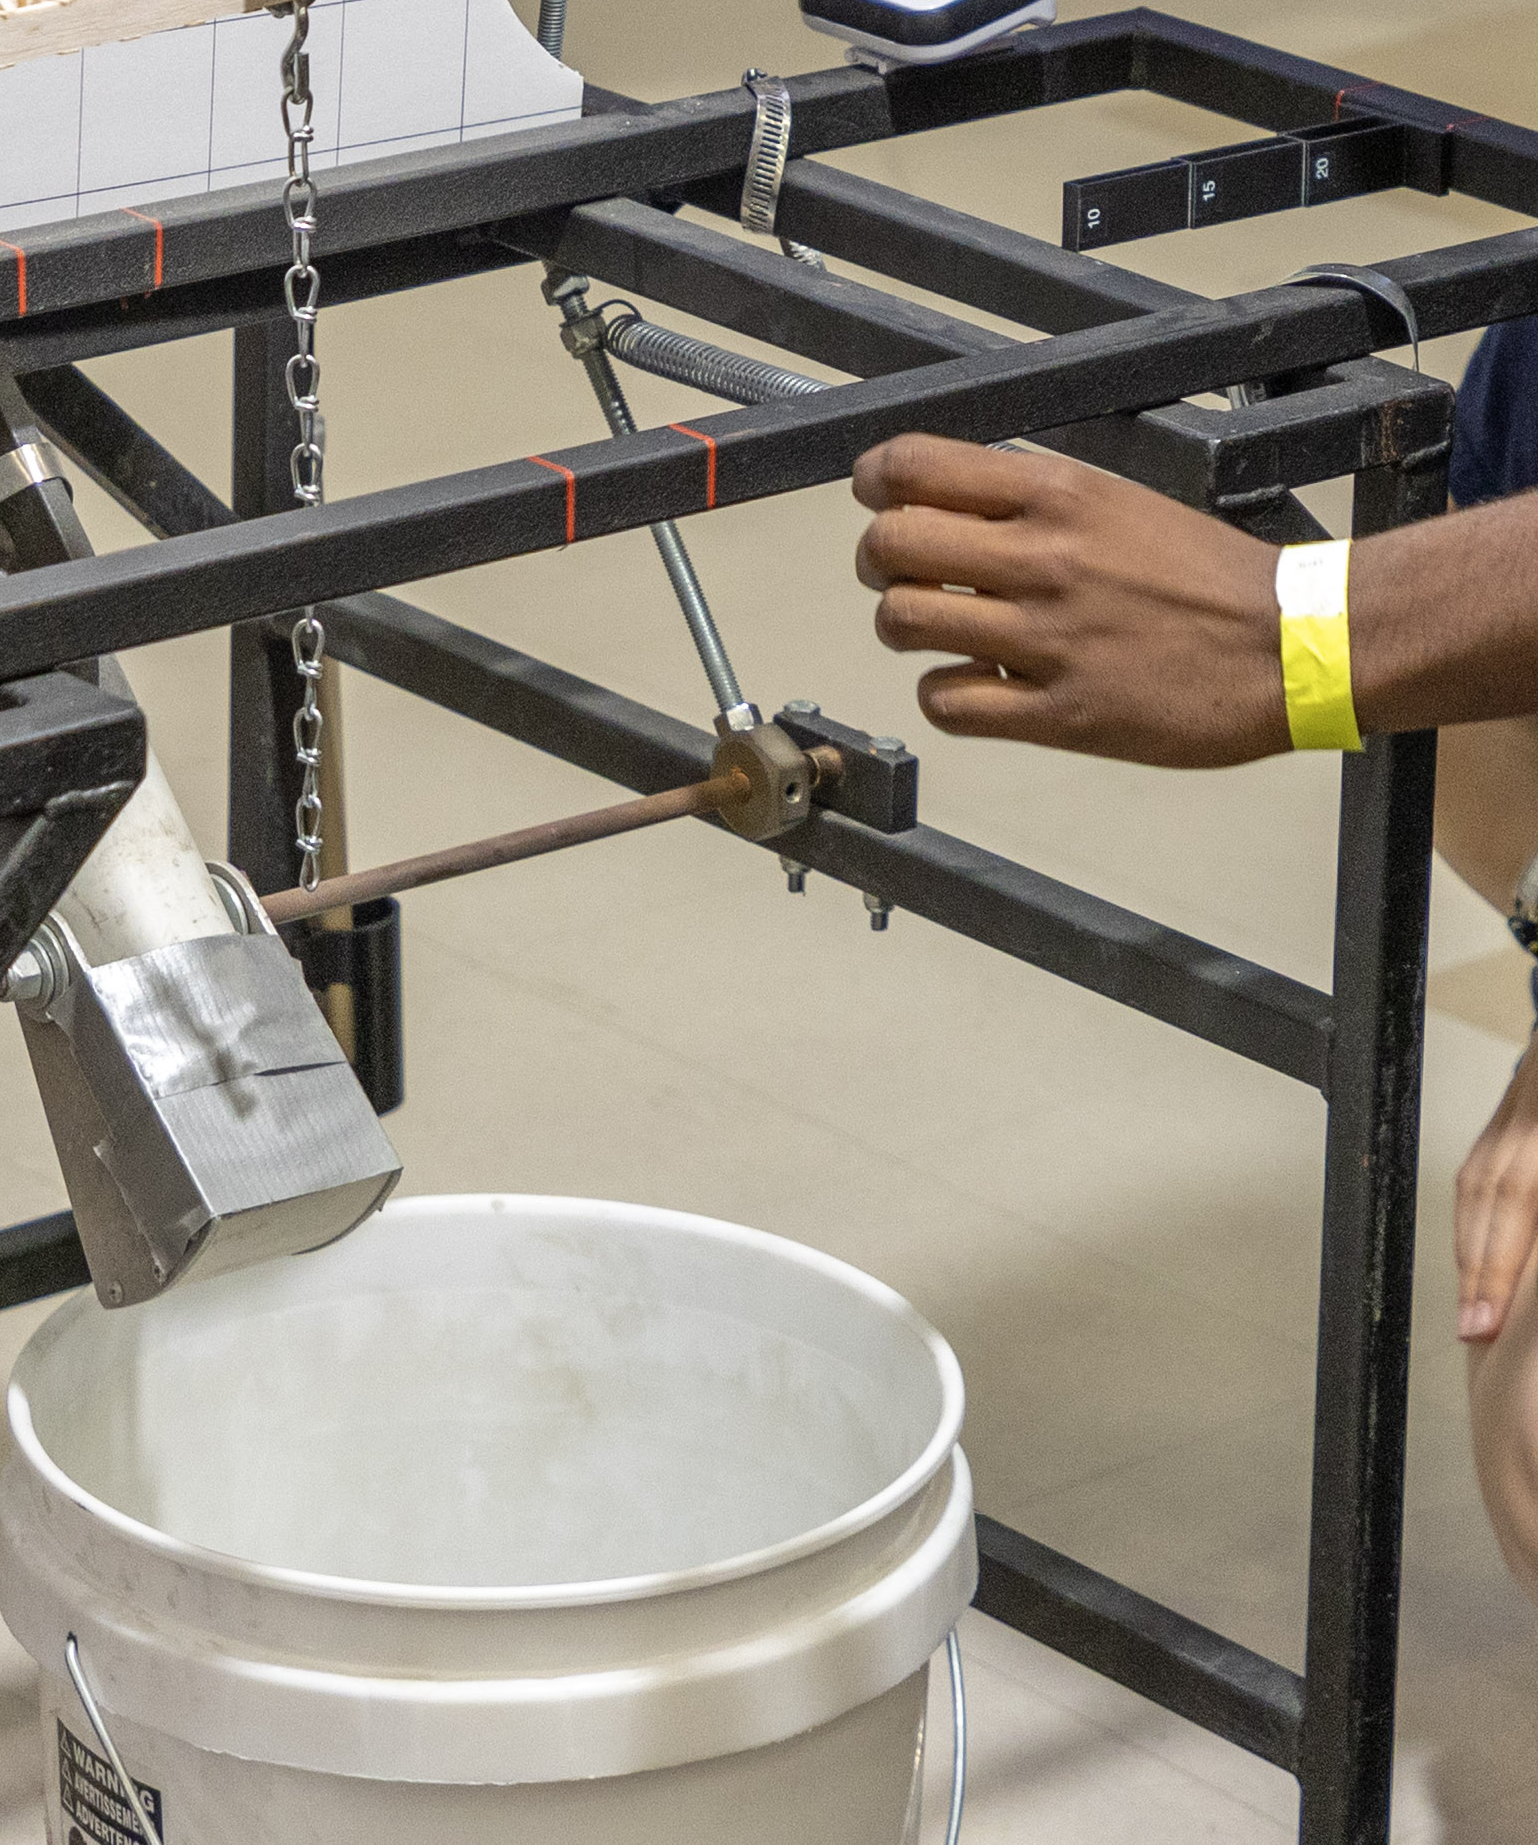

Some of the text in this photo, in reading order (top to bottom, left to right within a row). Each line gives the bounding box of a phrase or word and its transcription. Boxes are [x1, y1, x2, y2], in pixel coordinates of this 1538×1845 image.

[1316, 157, 1329, 180] 20
[1203, 180, 1216, 201] 15
[1087, 208, 1101, 229] 10
[72, 1741, 155, 1814] WARNG
